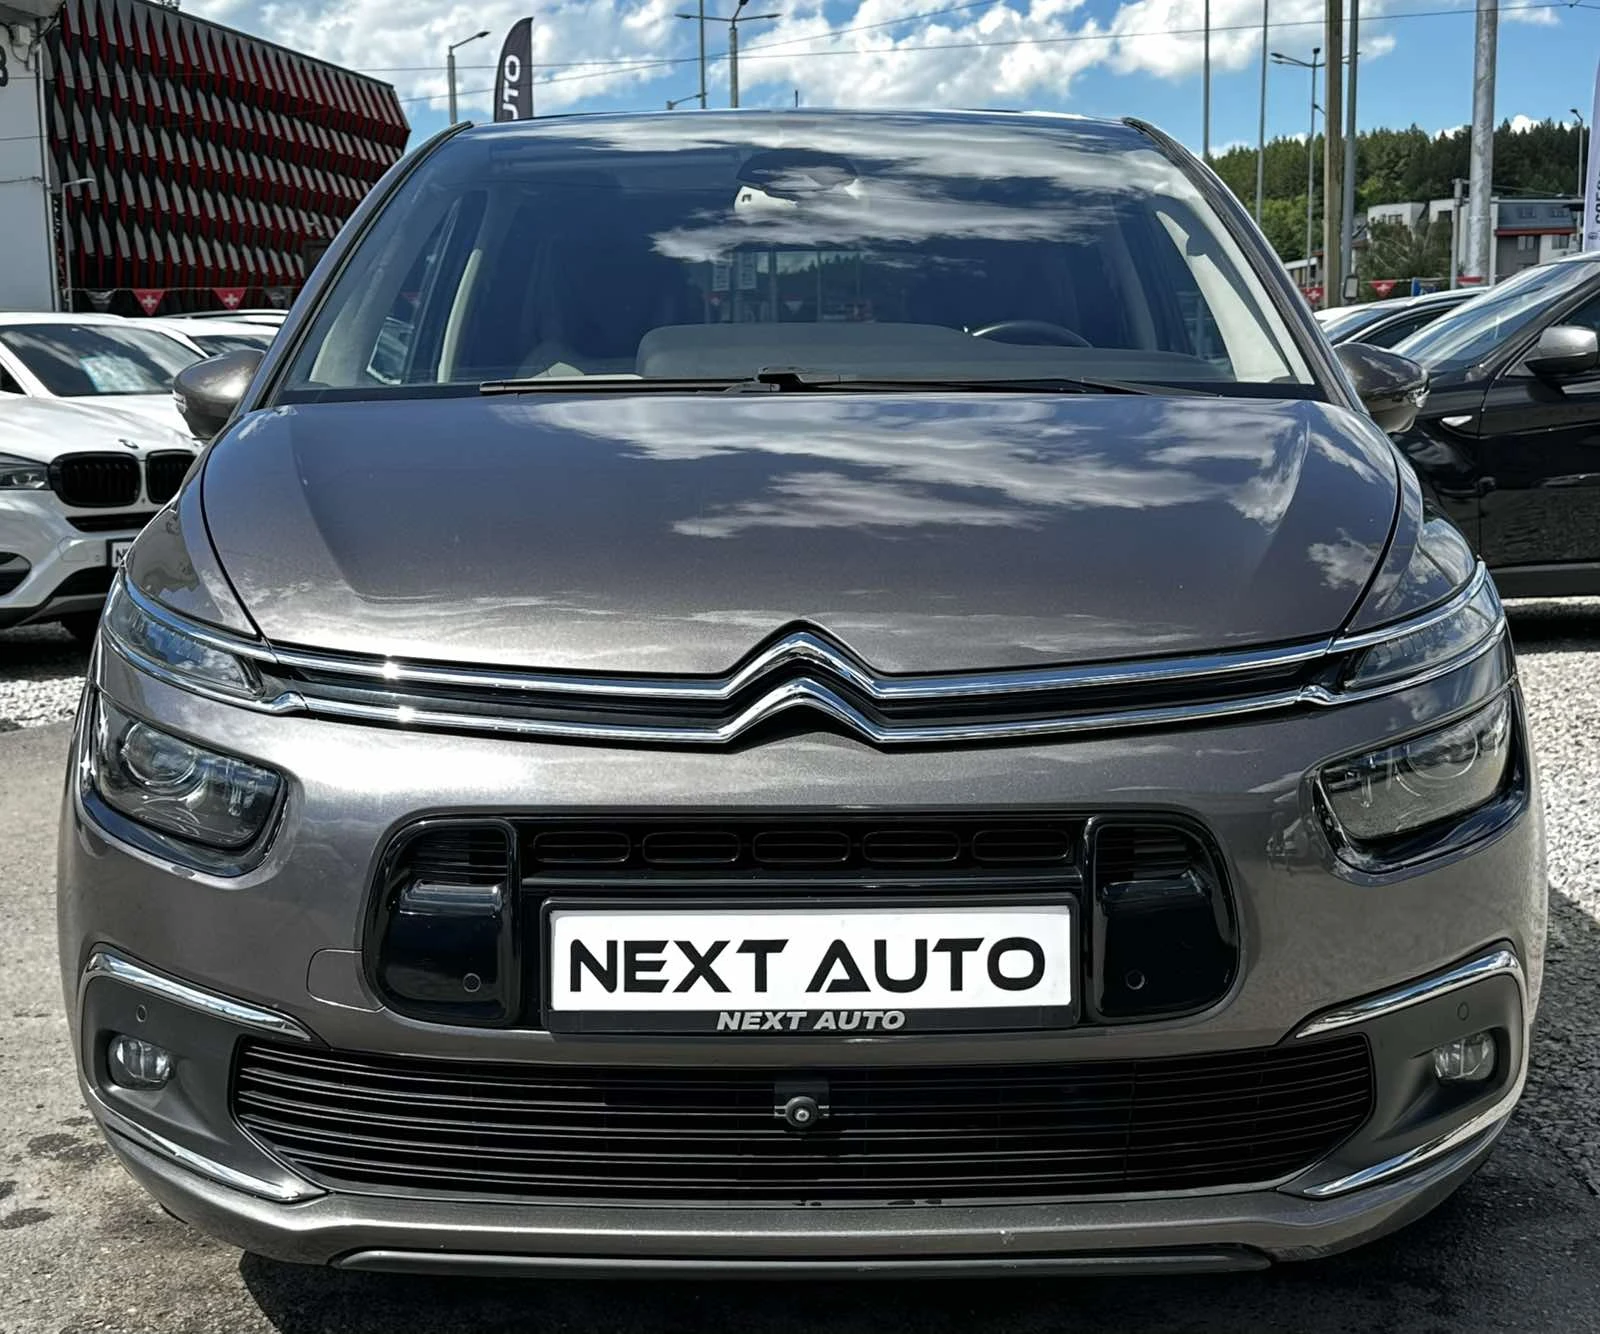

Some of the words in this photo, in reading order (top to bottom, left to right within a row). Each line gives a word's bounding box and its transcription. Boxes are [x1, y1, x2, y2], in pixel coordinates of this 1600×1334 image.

[569, 938, 789, 994] NEXT
[805, 936, 1046, 994] AUTO
[716, 1011, 806, 1031] NEXT
[813, 1010, 906, 1031] AUTO
